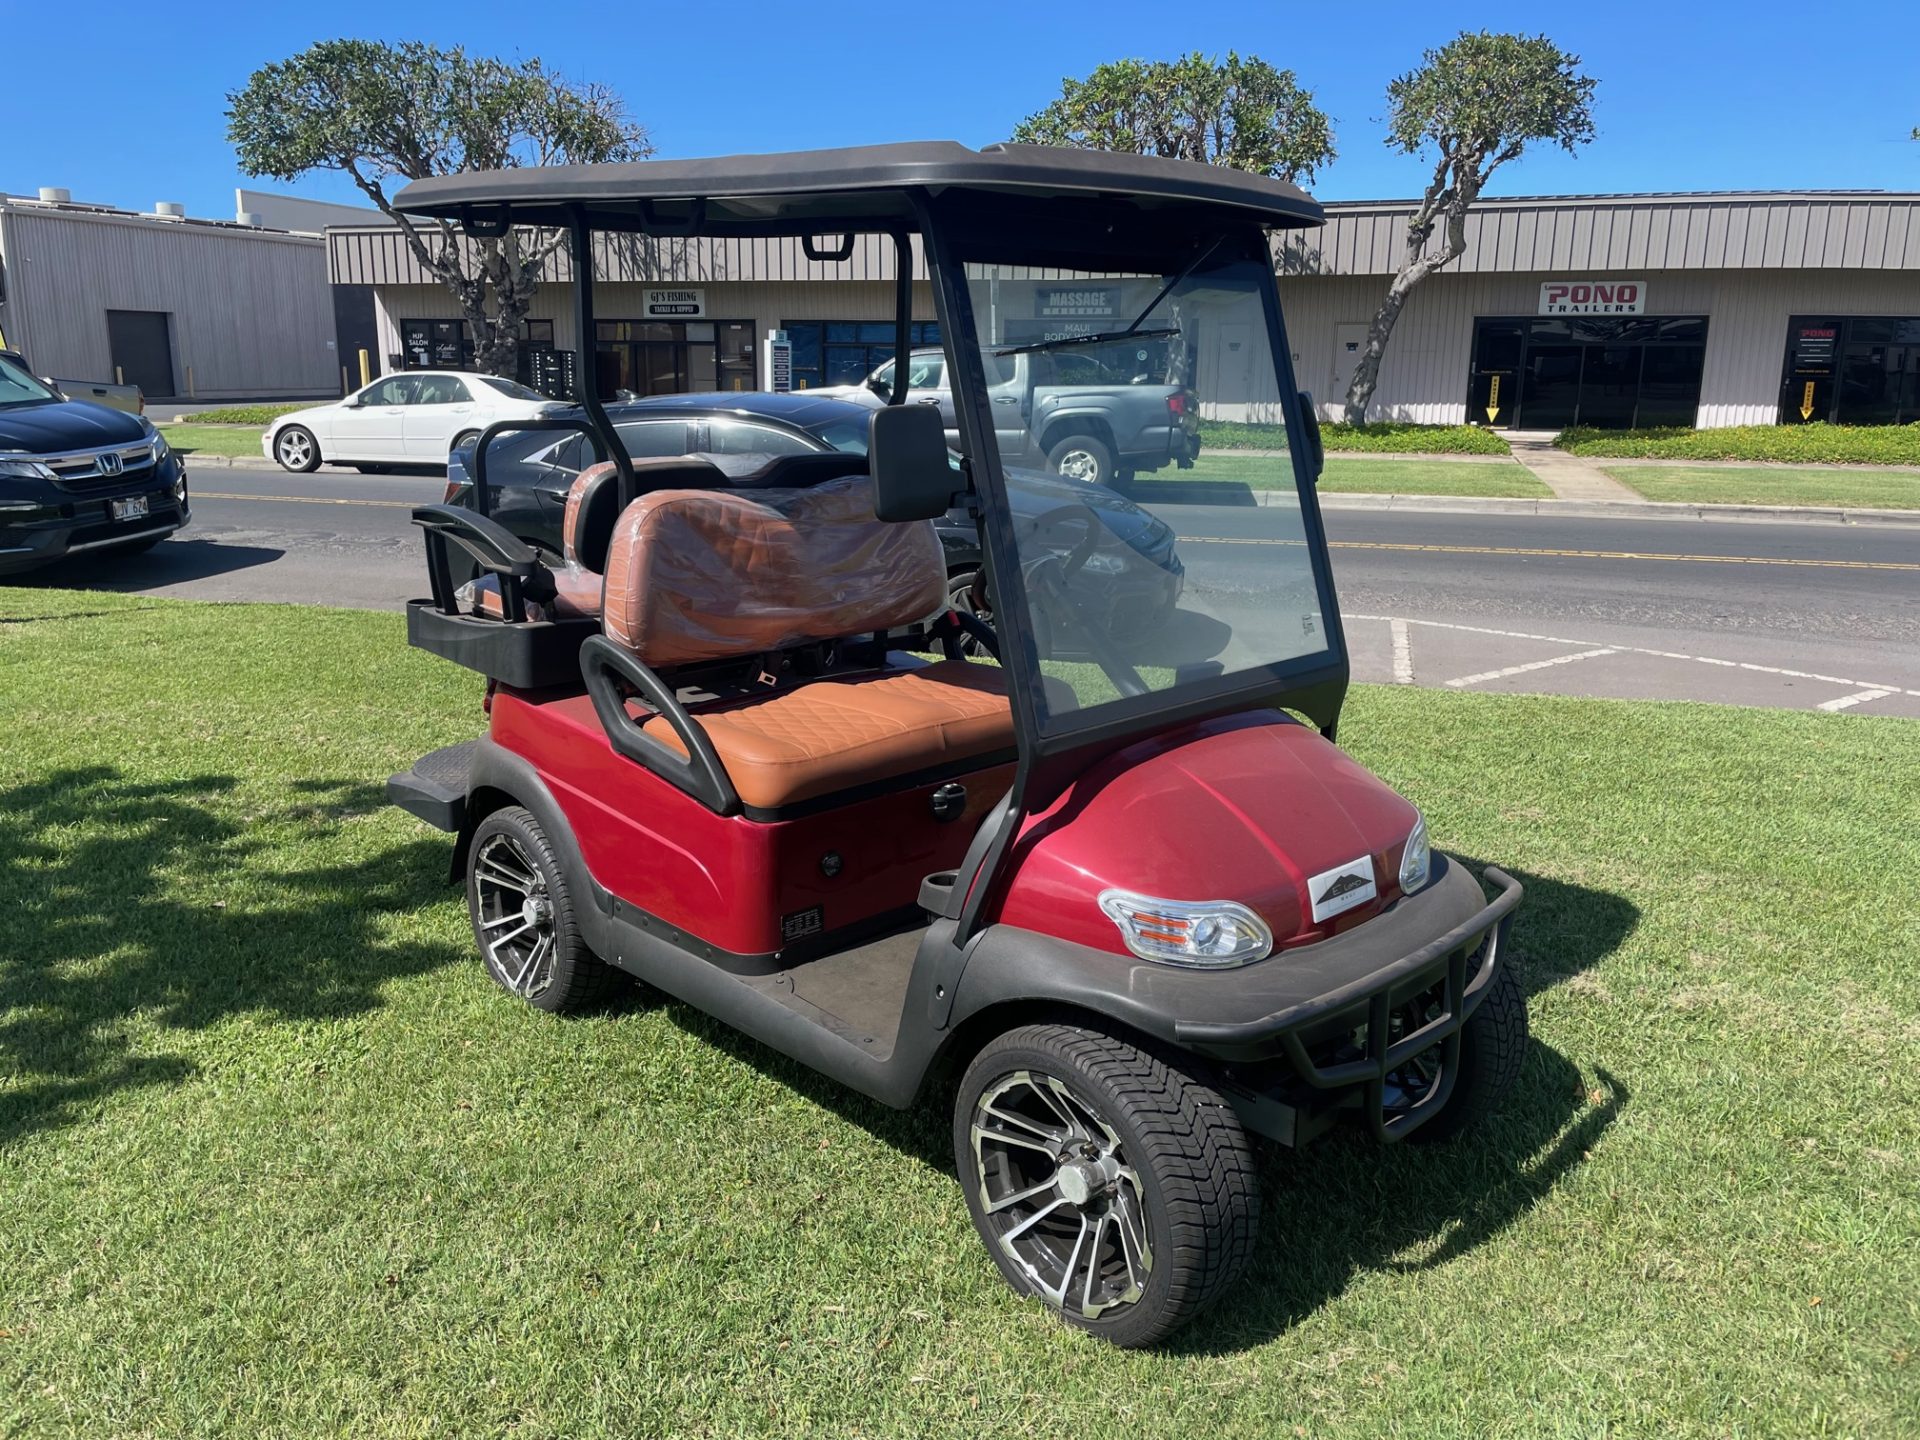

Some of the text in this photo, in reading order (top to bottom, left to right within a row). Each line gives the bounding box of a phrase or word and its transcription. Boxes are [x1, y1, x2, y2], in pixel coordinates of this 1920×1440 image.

[667, 291, 697, 301] FISHING
[1545, 285, 1637, 303] PONO
[1050, 292, 1106, 306] MASSAGE
[1064, 324, 1090, 332] MAUI
[1044, 333, 1071, 341] BODY
[1802, 329, 1835, 337] PONO
